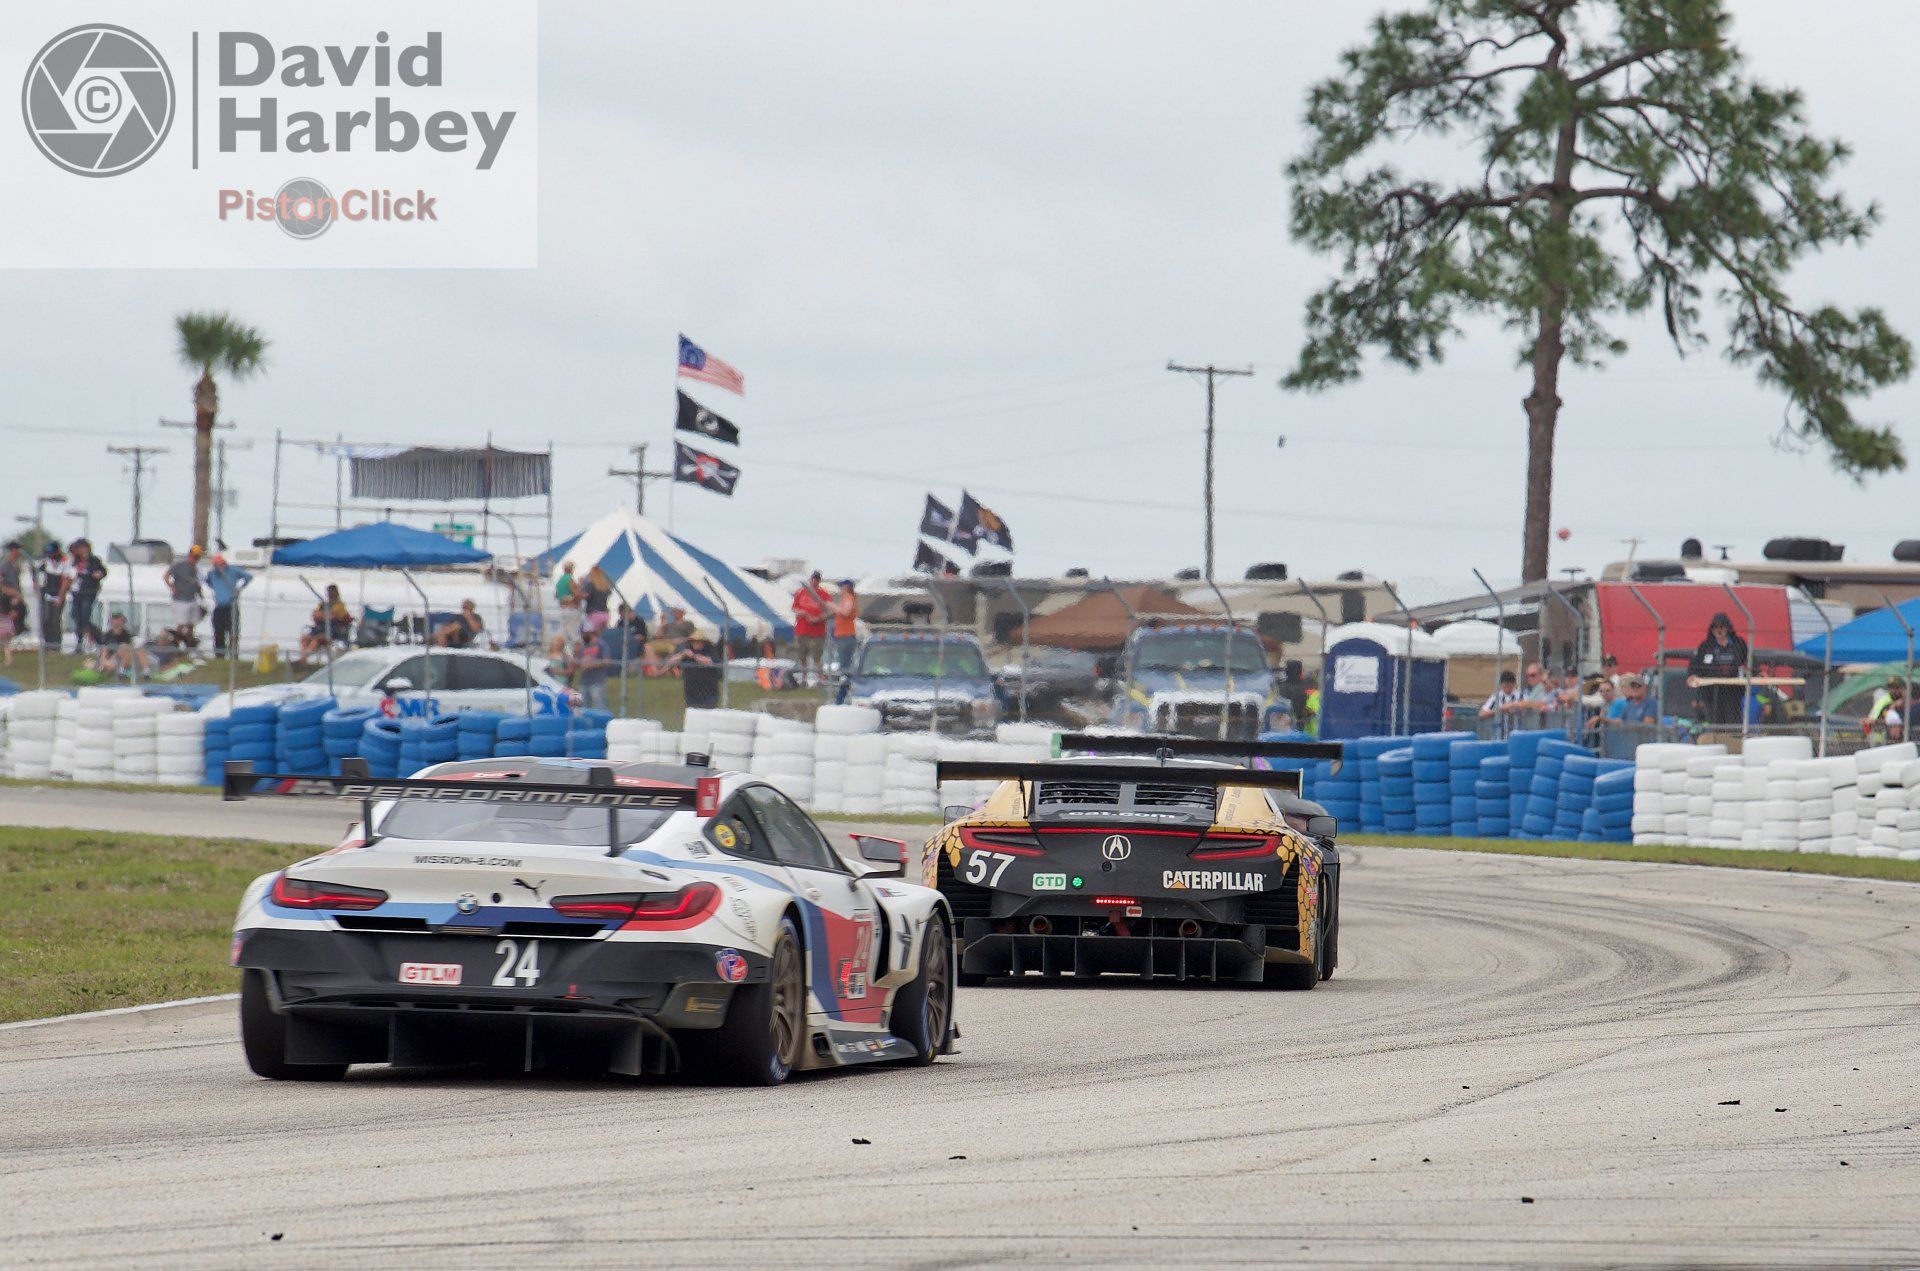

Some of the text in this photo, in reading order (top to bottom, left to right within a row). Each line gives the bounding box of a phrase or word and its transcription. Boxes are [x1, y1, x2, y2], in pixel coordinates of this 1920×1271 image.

[340, 784, 682, 807] PERFORMANCE
[1068, 811, 1176, 819] cat.com
[965, 849, 1016, 888] 57
[1034, 876, 1064, 887] GTD
[1162, 870, 1264, 892] CATERPILLAR
[404, 966, 458, 981] GTLM
[491, 939, 541, 987] 24
